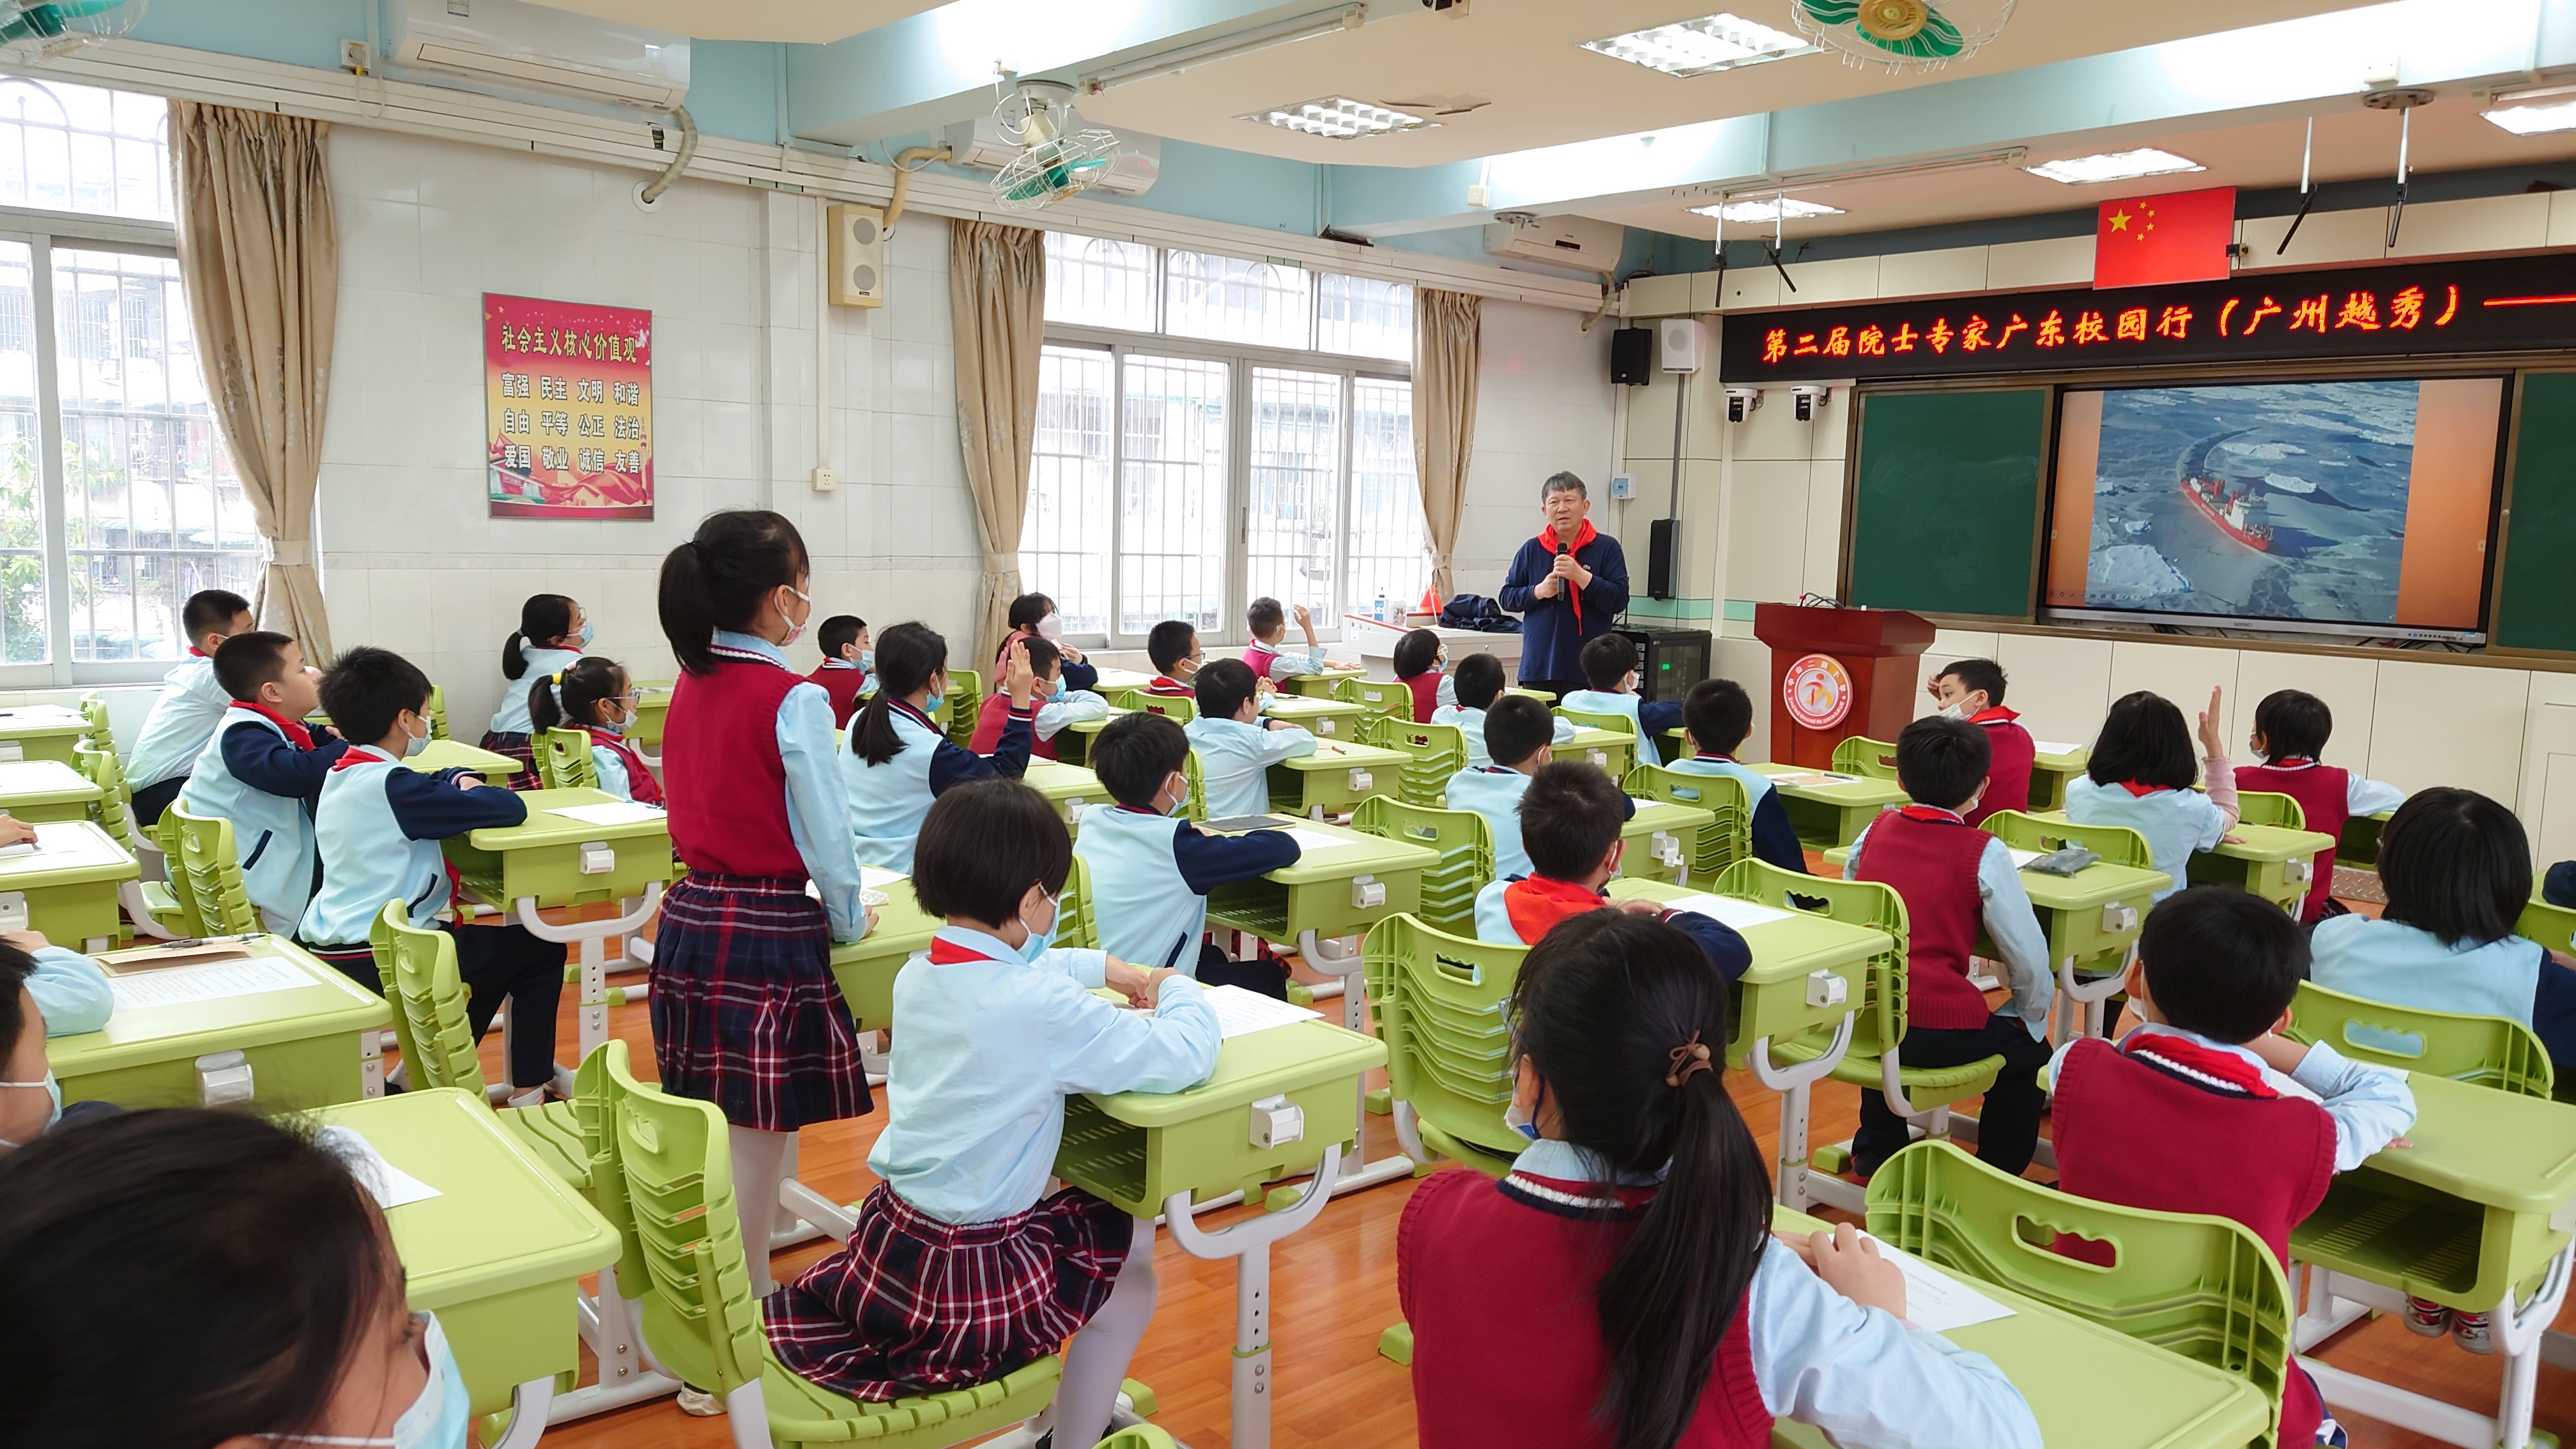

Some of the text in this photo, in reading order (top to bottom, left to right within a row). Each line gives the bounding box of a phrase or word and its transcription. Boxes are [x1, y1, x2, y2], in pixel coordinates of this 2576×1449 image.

[502, 324, 637, 364] 社会主义核心价值观
[502, 372, 640, 406] 富强 民主 文明 和谐
[503, 408, 640, 440] 自由 平等 公正 法治
[504, 444, 640, 474] 爱国 敬业 诚信 友善
